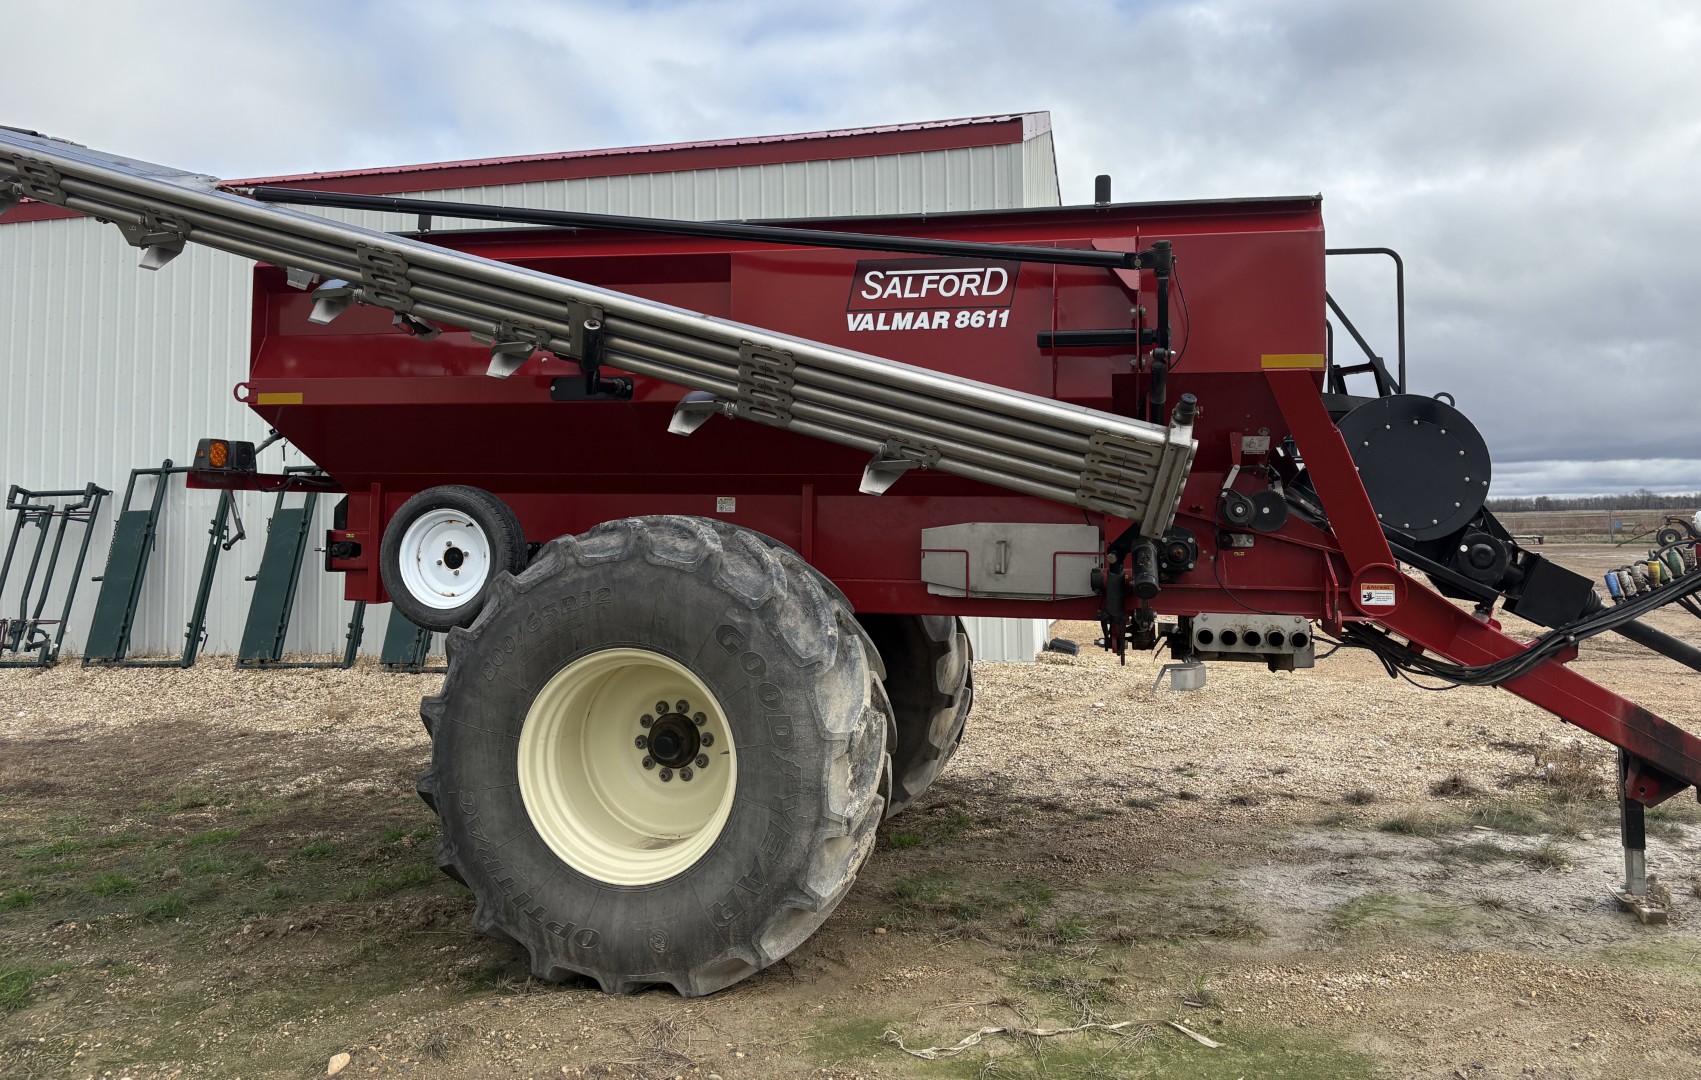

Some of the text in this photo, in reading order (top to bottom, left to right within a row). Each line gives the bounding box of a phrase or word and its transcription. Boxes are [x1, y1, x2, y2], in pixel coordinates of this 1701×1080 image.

[846, 309, 1010, 331] VALMAR 8611
[861, 267, 1008, 300] SALFORD
[708, 624, 802, 927] GOODYEAR
[458, 789, 601, 949] OPTITRAC
